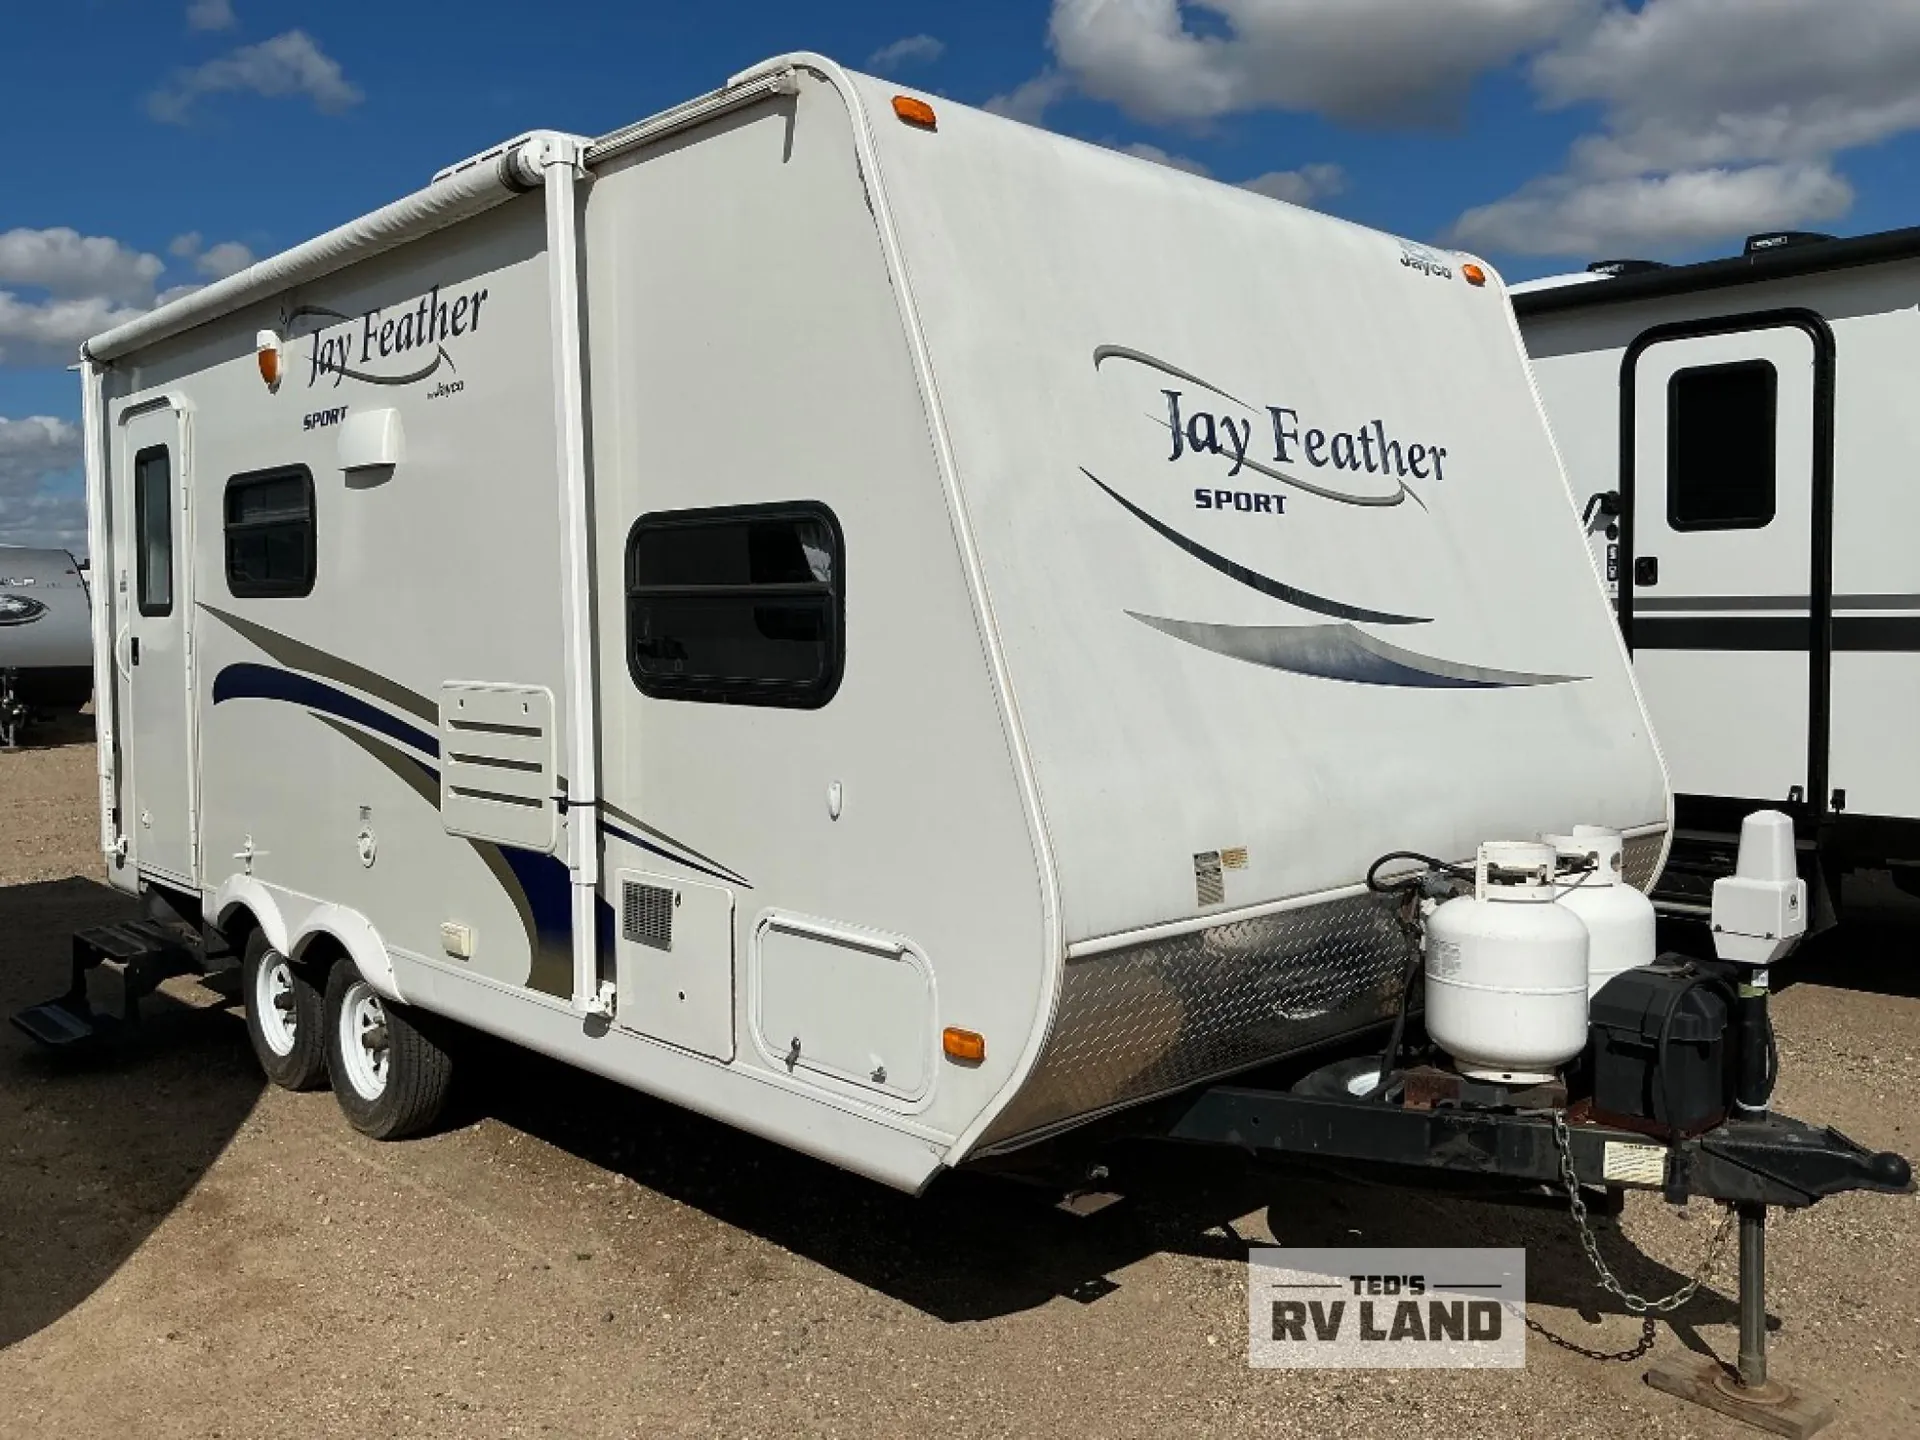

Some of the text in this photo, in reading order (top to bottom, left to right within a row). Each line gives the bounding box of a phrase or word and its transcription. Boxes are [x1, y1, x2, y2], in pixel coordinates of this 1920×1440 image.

[1399, 250, 1452, 280] Jayco
[308, 284, 490, 389] Jay Feather
[303, 405, 349, 432] SPORT
[1160, 389, 1447, 481] Jay Feather
[1194, 488, 1287, 515] SPORT
